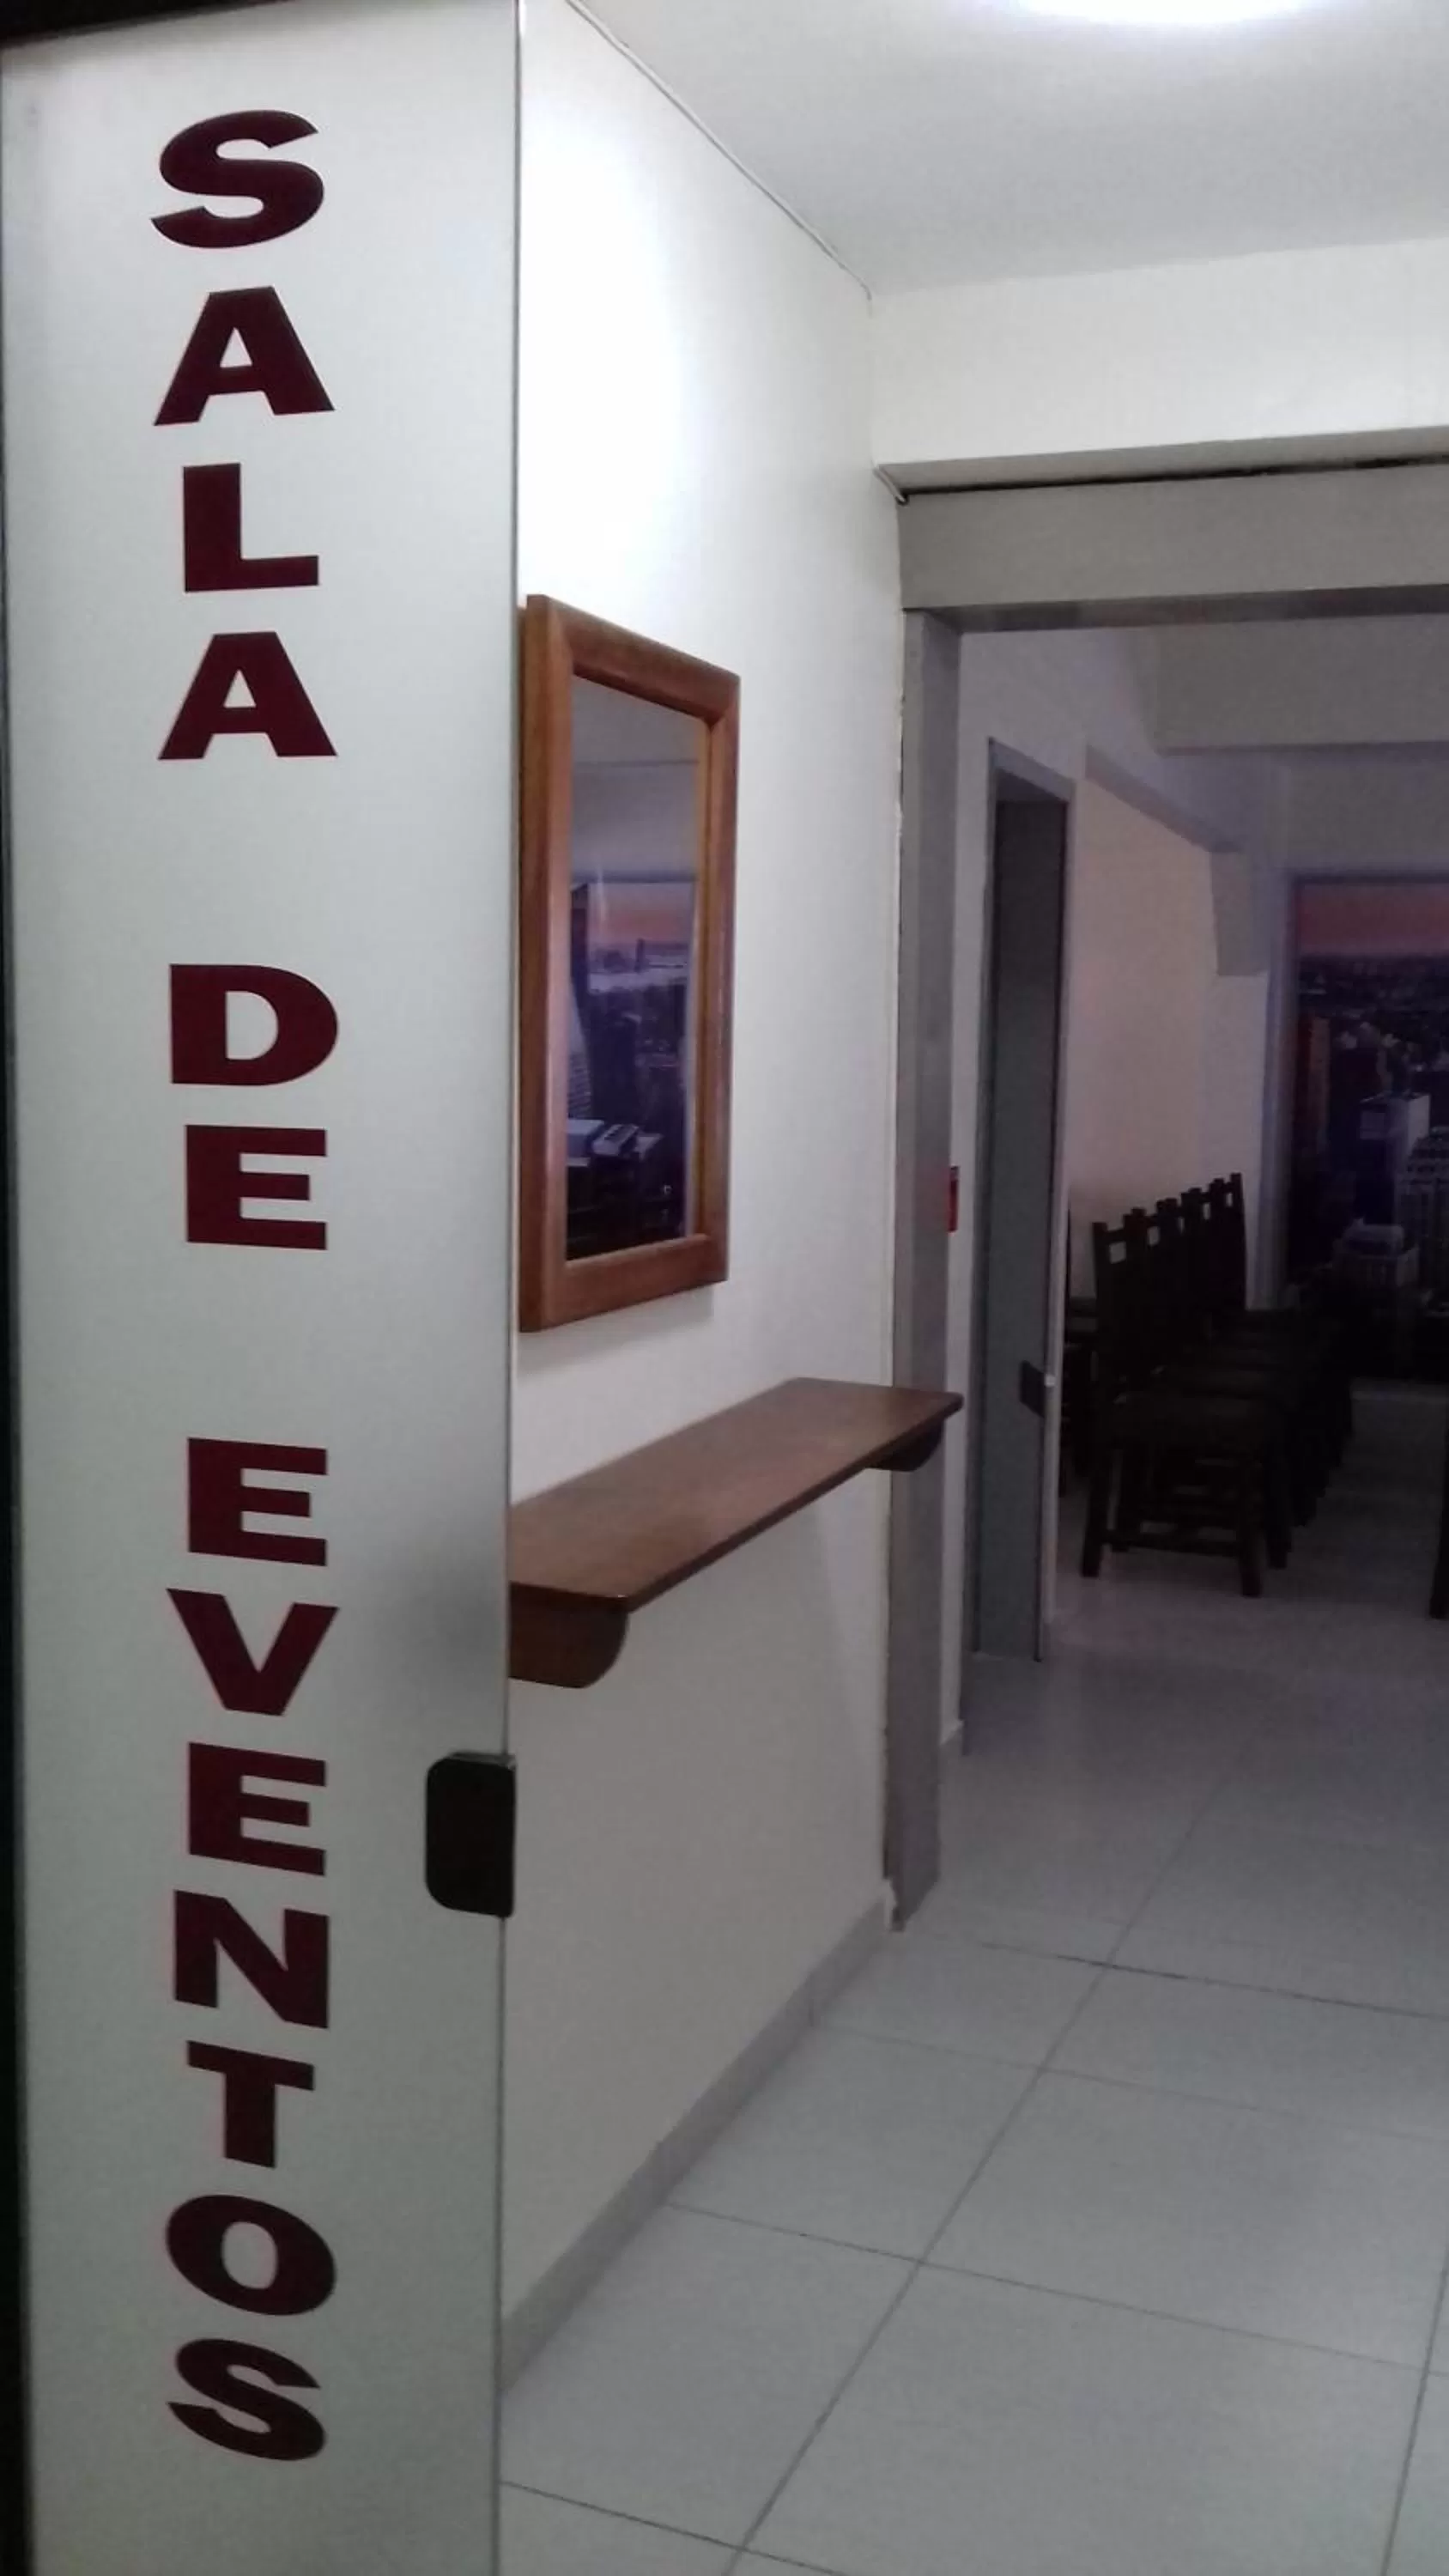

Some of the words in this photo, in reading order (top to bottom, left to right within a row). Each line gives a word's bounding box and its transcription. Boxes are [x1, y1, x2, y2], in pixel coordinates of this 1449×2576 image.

[152, 111, 336, 761] SALA
[169, 963, 340, 1251] DE
[165, 1437, 339, 2462] EVENTOS
